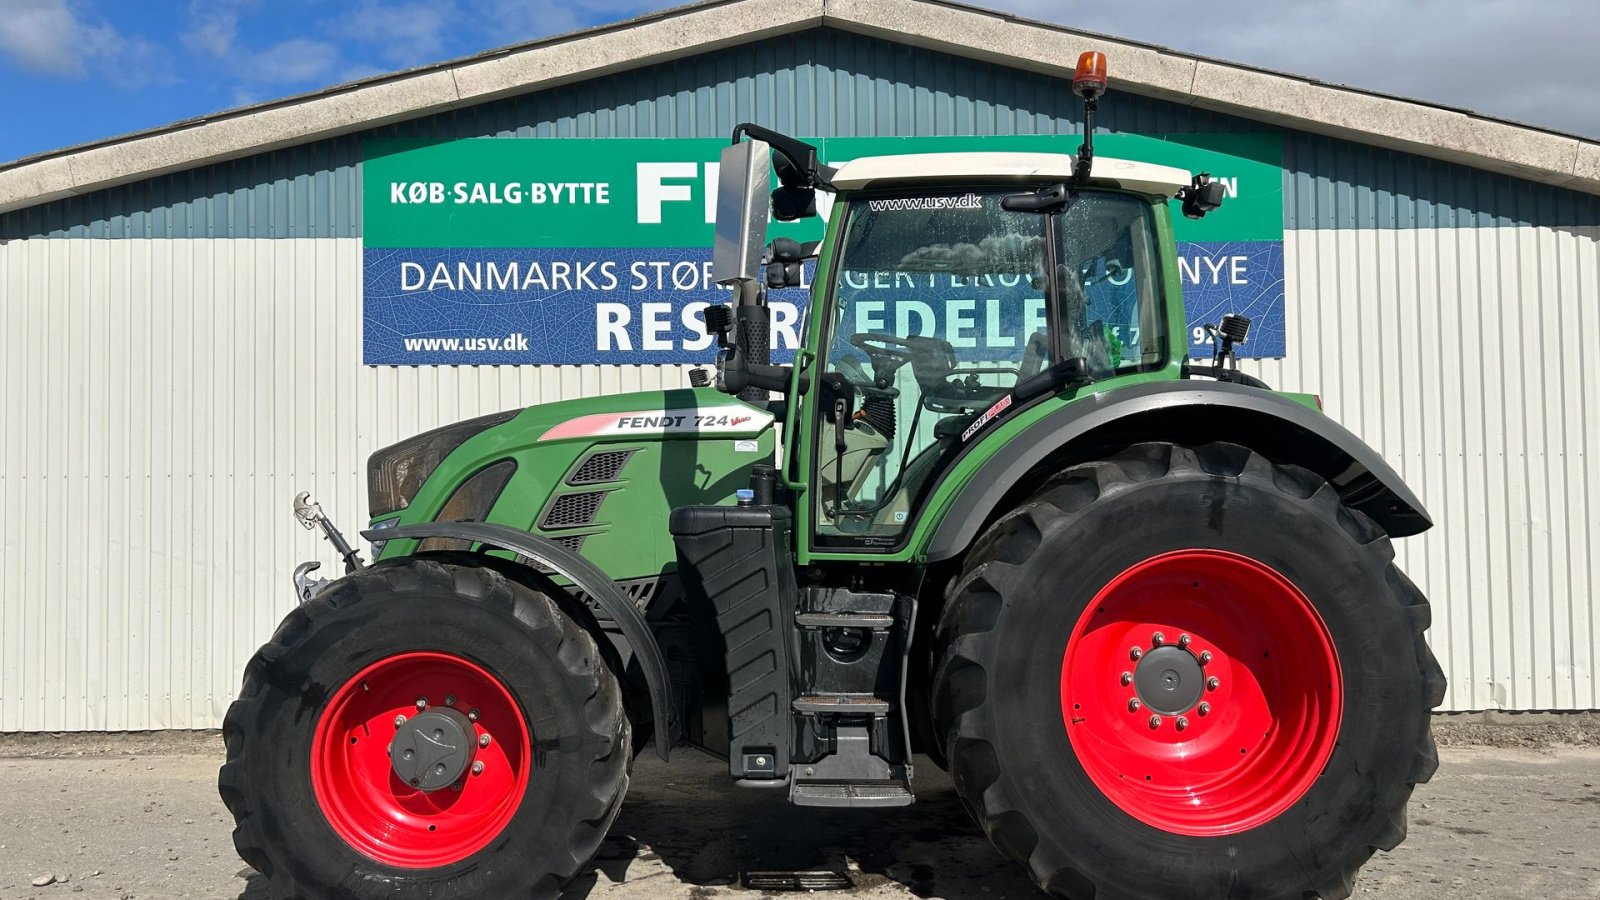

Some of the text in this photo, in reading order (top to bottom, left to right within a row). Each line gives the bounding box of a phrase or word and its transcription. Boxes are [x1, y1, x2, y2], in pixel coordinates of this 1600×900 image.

[869, 193, 983, 212] www.usv.dk
[400, 260, 618, 291] DANMARKS
[404, 332, 529, 352] www.usv.dk
[617, 415, 687, 429] FENDT
[694, 415, 729, 427] 724
